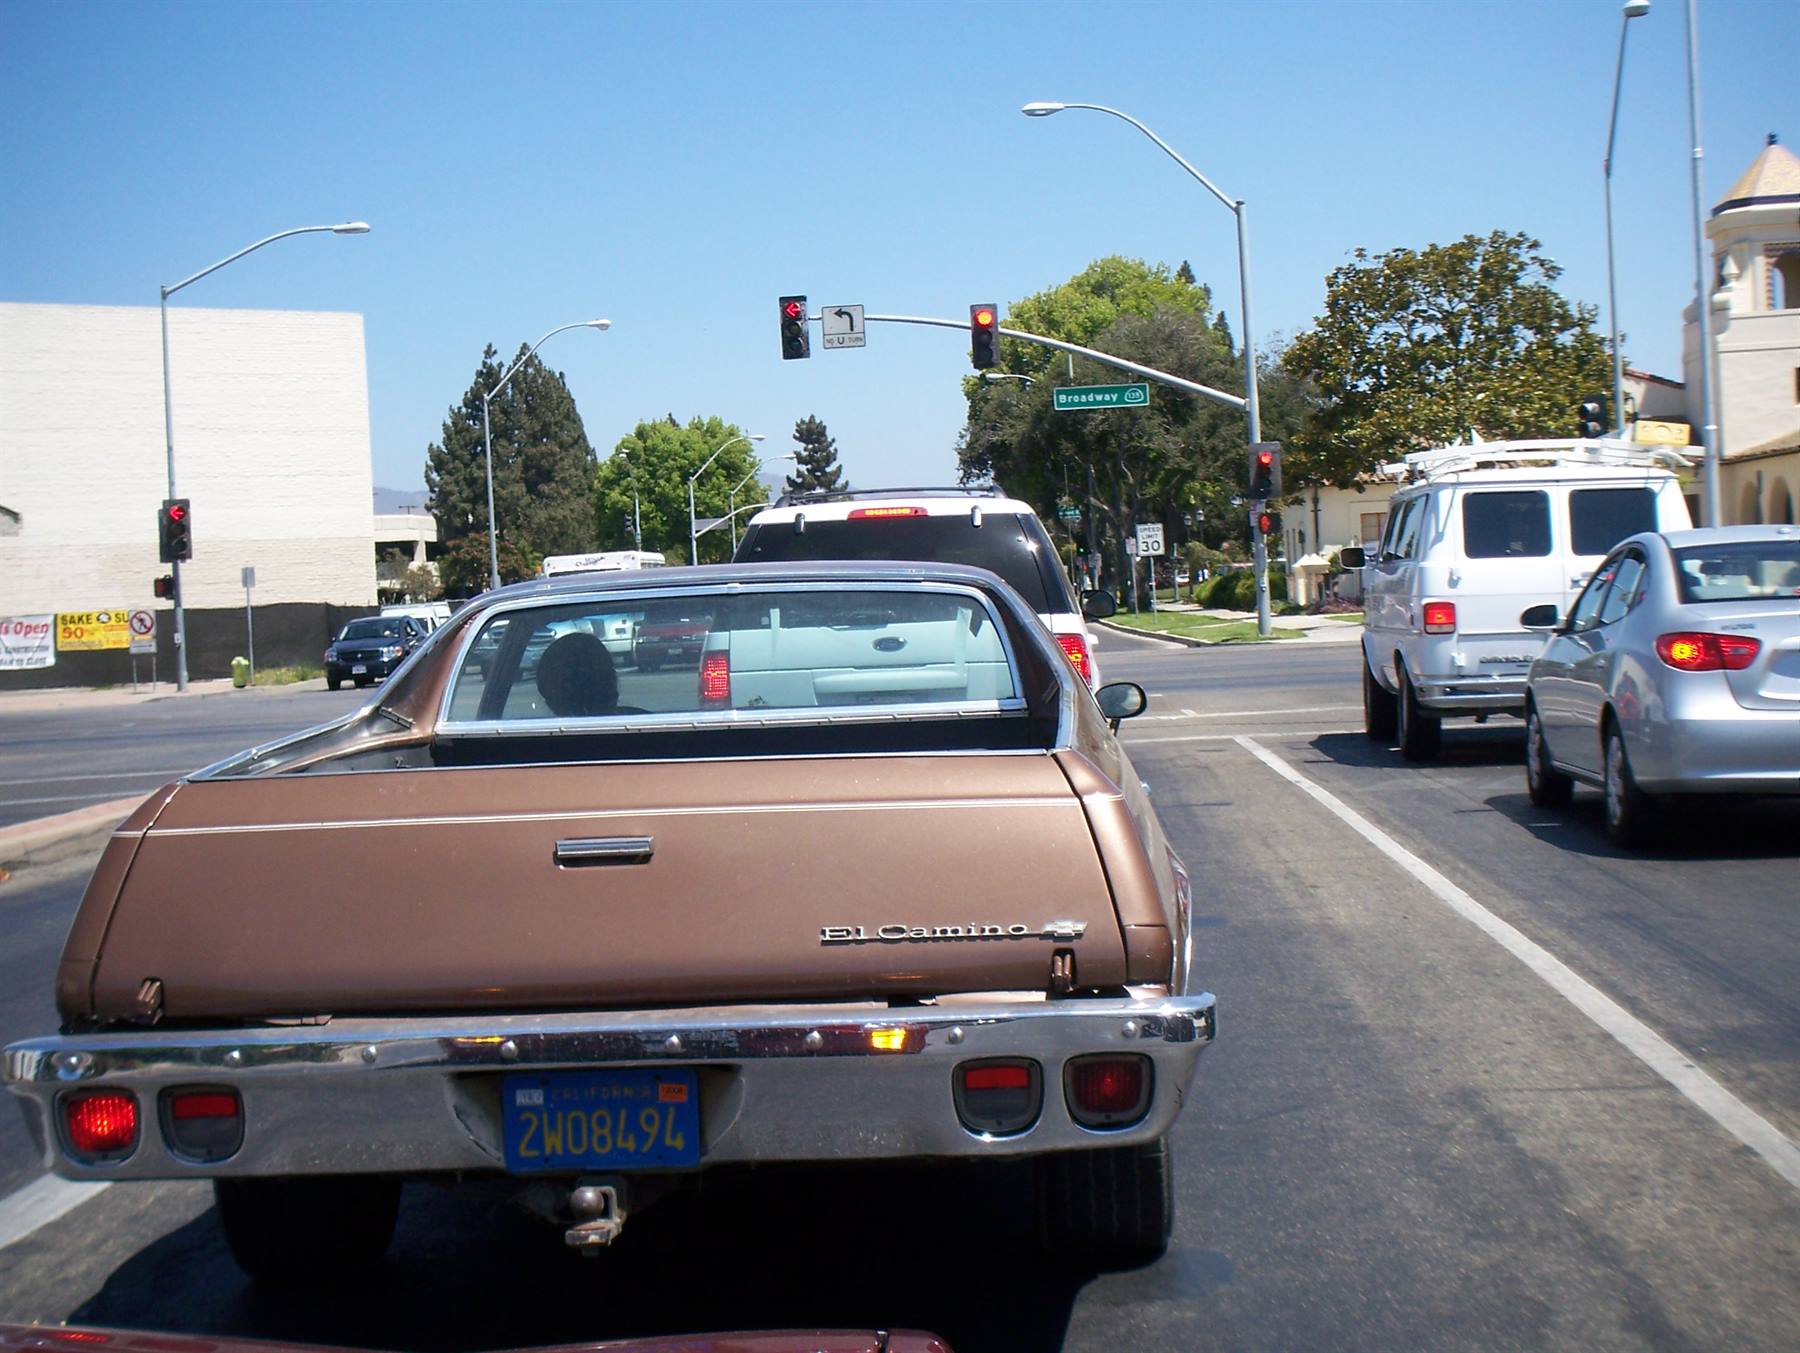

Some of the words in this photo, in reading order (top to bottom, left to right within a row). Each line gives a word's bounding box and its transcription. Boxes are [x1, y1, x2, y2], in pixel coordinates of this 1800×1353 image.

[837, 336, 845, 345] U
[1058, 393, 1118, 403] Broadway
[1141, 540, 1161, 552] 30
[61, 614, 93, 625] SAKE
[14, 621, 49, 637] Open
[821, 925, 866, 944] El
[878, 921, 1029, 944] Camino
[552, 1086, 651, 1099] CALIFORNIA
[519, 1106, 686, 1158] 2W08494
